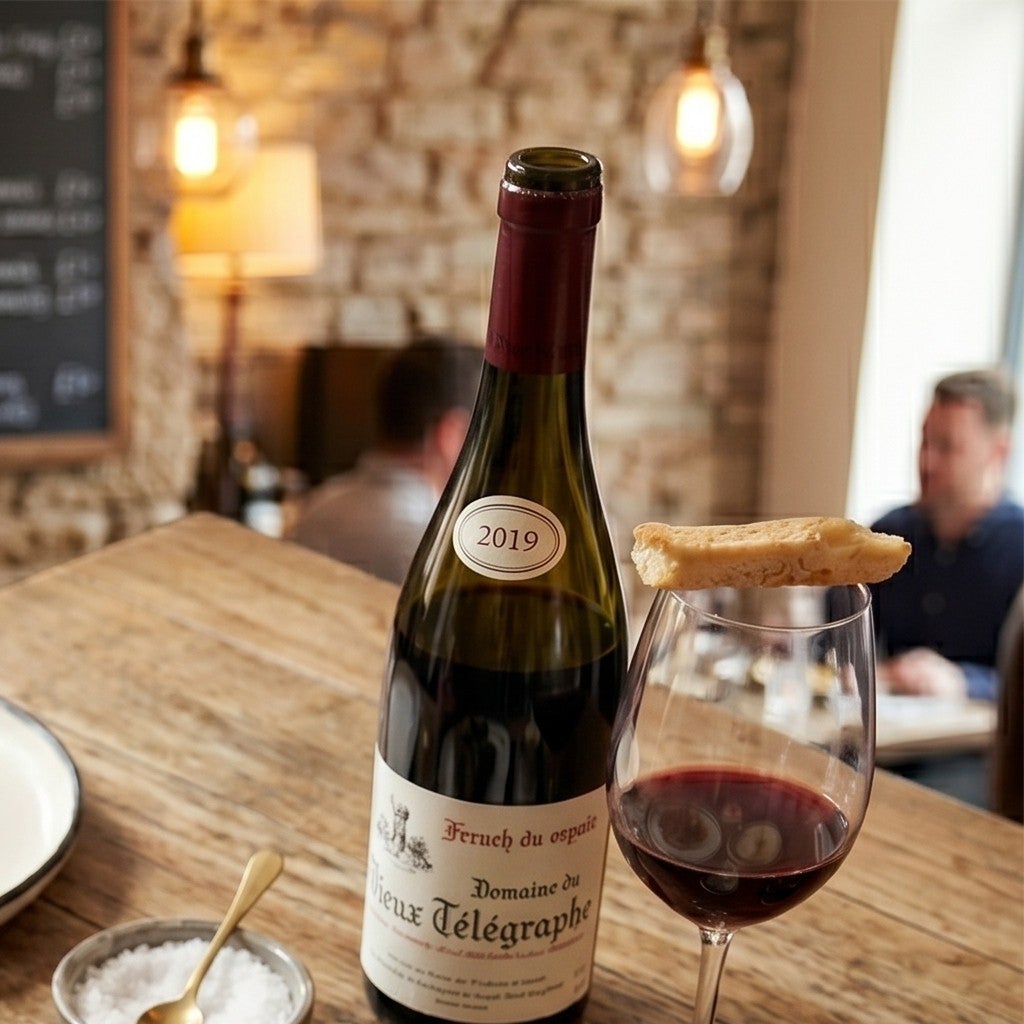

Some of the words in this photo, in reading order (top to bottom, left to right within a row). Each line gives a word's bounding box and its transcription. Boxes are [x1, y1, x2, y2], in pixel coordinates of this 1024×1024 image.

[476, 525, 539, 552] 2019
[520, 830, 543, 847] du
[470, 876, 558, 900] Domaine
[562, 873, 580, 891] du
[432, 896, 592, 949] Télégraphe
